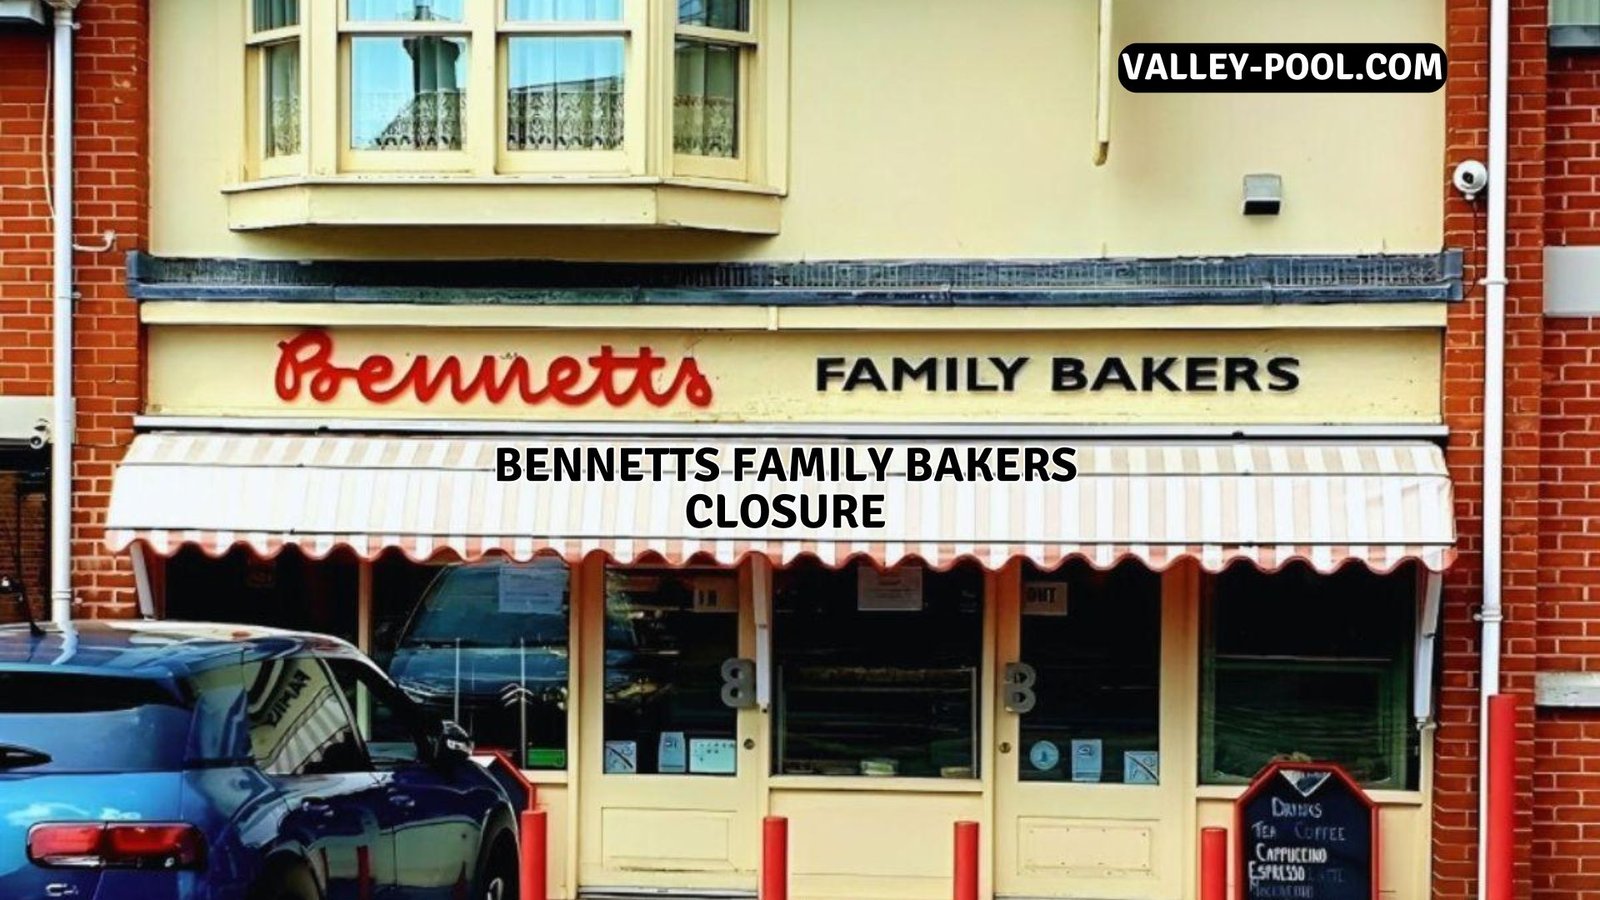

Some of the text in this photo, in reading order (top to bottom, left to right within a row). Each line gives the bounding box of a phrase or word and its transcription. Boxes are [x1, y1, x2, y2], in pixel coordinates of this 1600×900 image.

[275, 327, 714, 407] Bennetts
[815, 356, 1301, 392] FAMILY BAKERS
[1255, 842, 1328, 864] CAPPUCCINO
